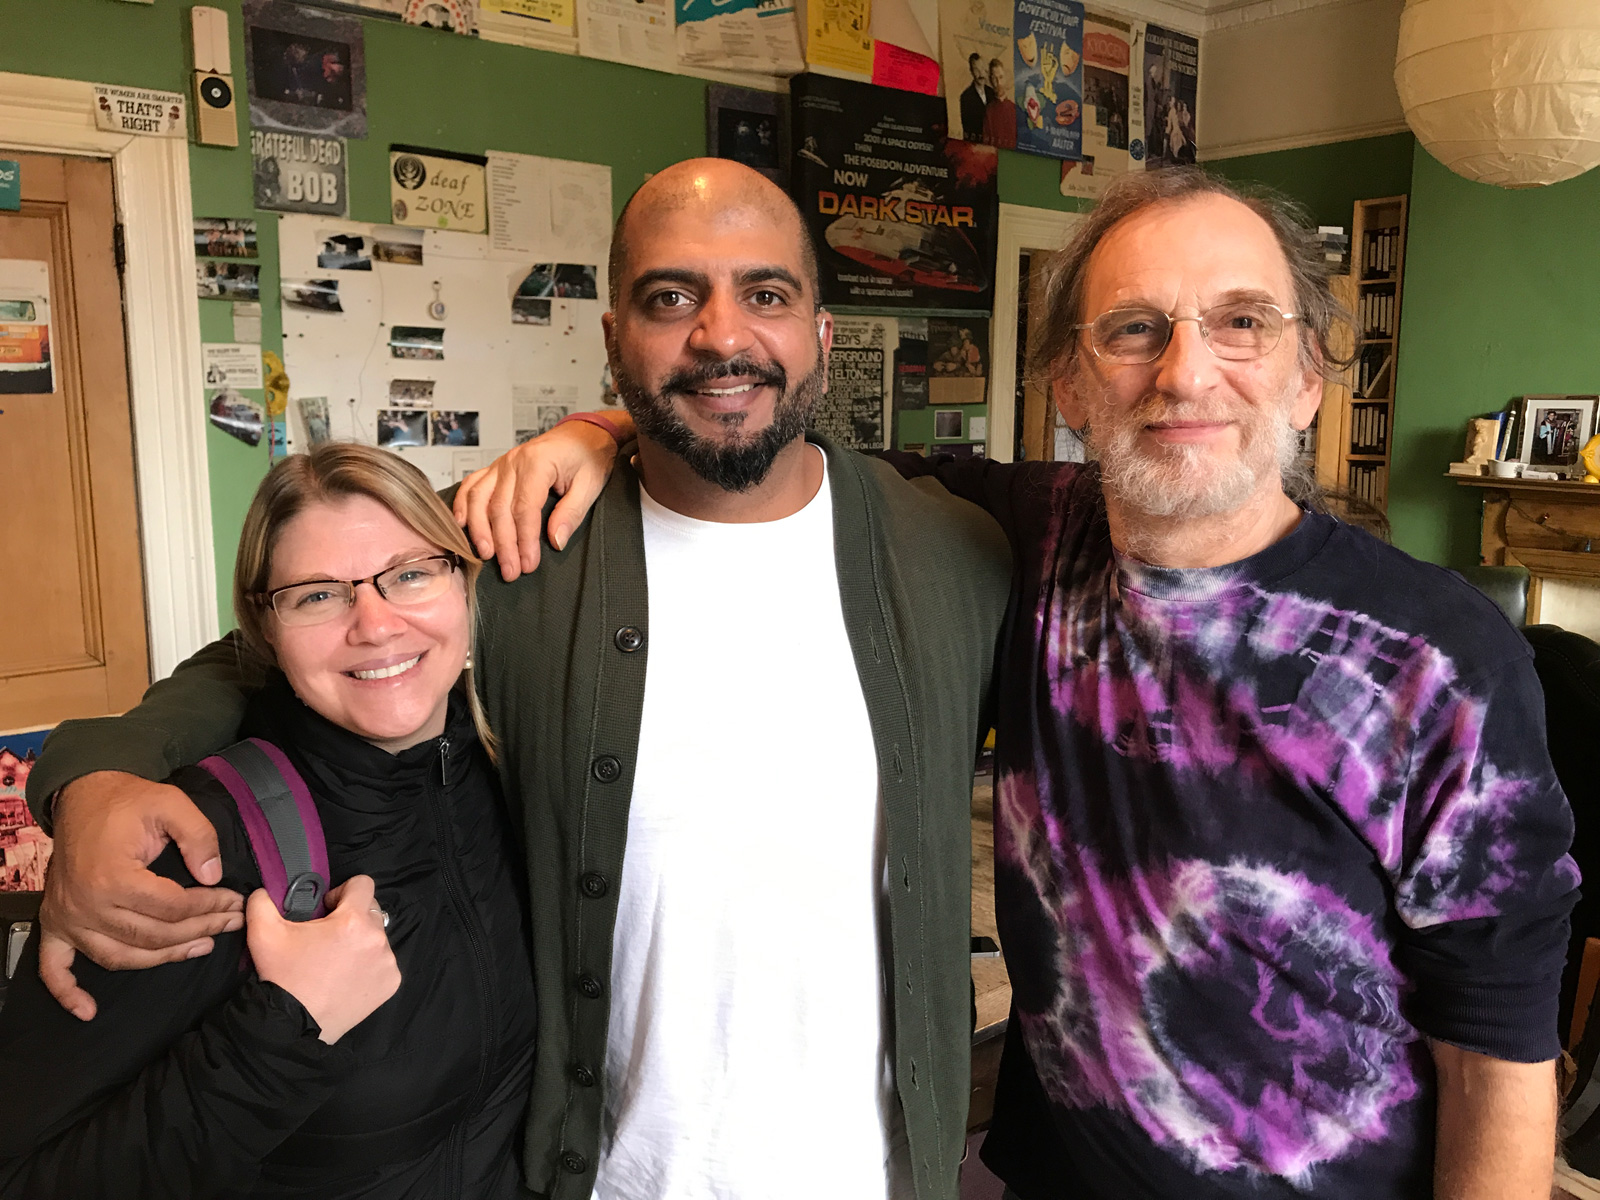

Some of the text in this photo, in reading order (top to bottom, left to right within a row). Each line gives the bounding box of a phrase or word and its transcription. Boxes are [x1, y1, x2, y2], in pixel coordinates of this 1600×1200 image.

[1029, 20, 1067, 39] FESTIVAL
[94, 86, 108, 95] THE
[110, 89, 135, 98] WOMEN
[137, 92, 150, 100] ARE
[117, 100, 163, 118] THAT'S
[121, 116, 161, 132] RIGHT
[309, 138, 341, 165] DEAD
[854, 142, 872, 153] THEN
[887, 138, 907, 149] SPACE
[843, 154, 948, 178] THE POSEIDON ADVENTURE
[287, 169, 338, 204] BOB
[430, 169, 470, 196] deaf
[833, 169, 869, 188] NOW
[415, 196, 475, 220] ZONE
[818, 190, 974, 228] DARK STAR
